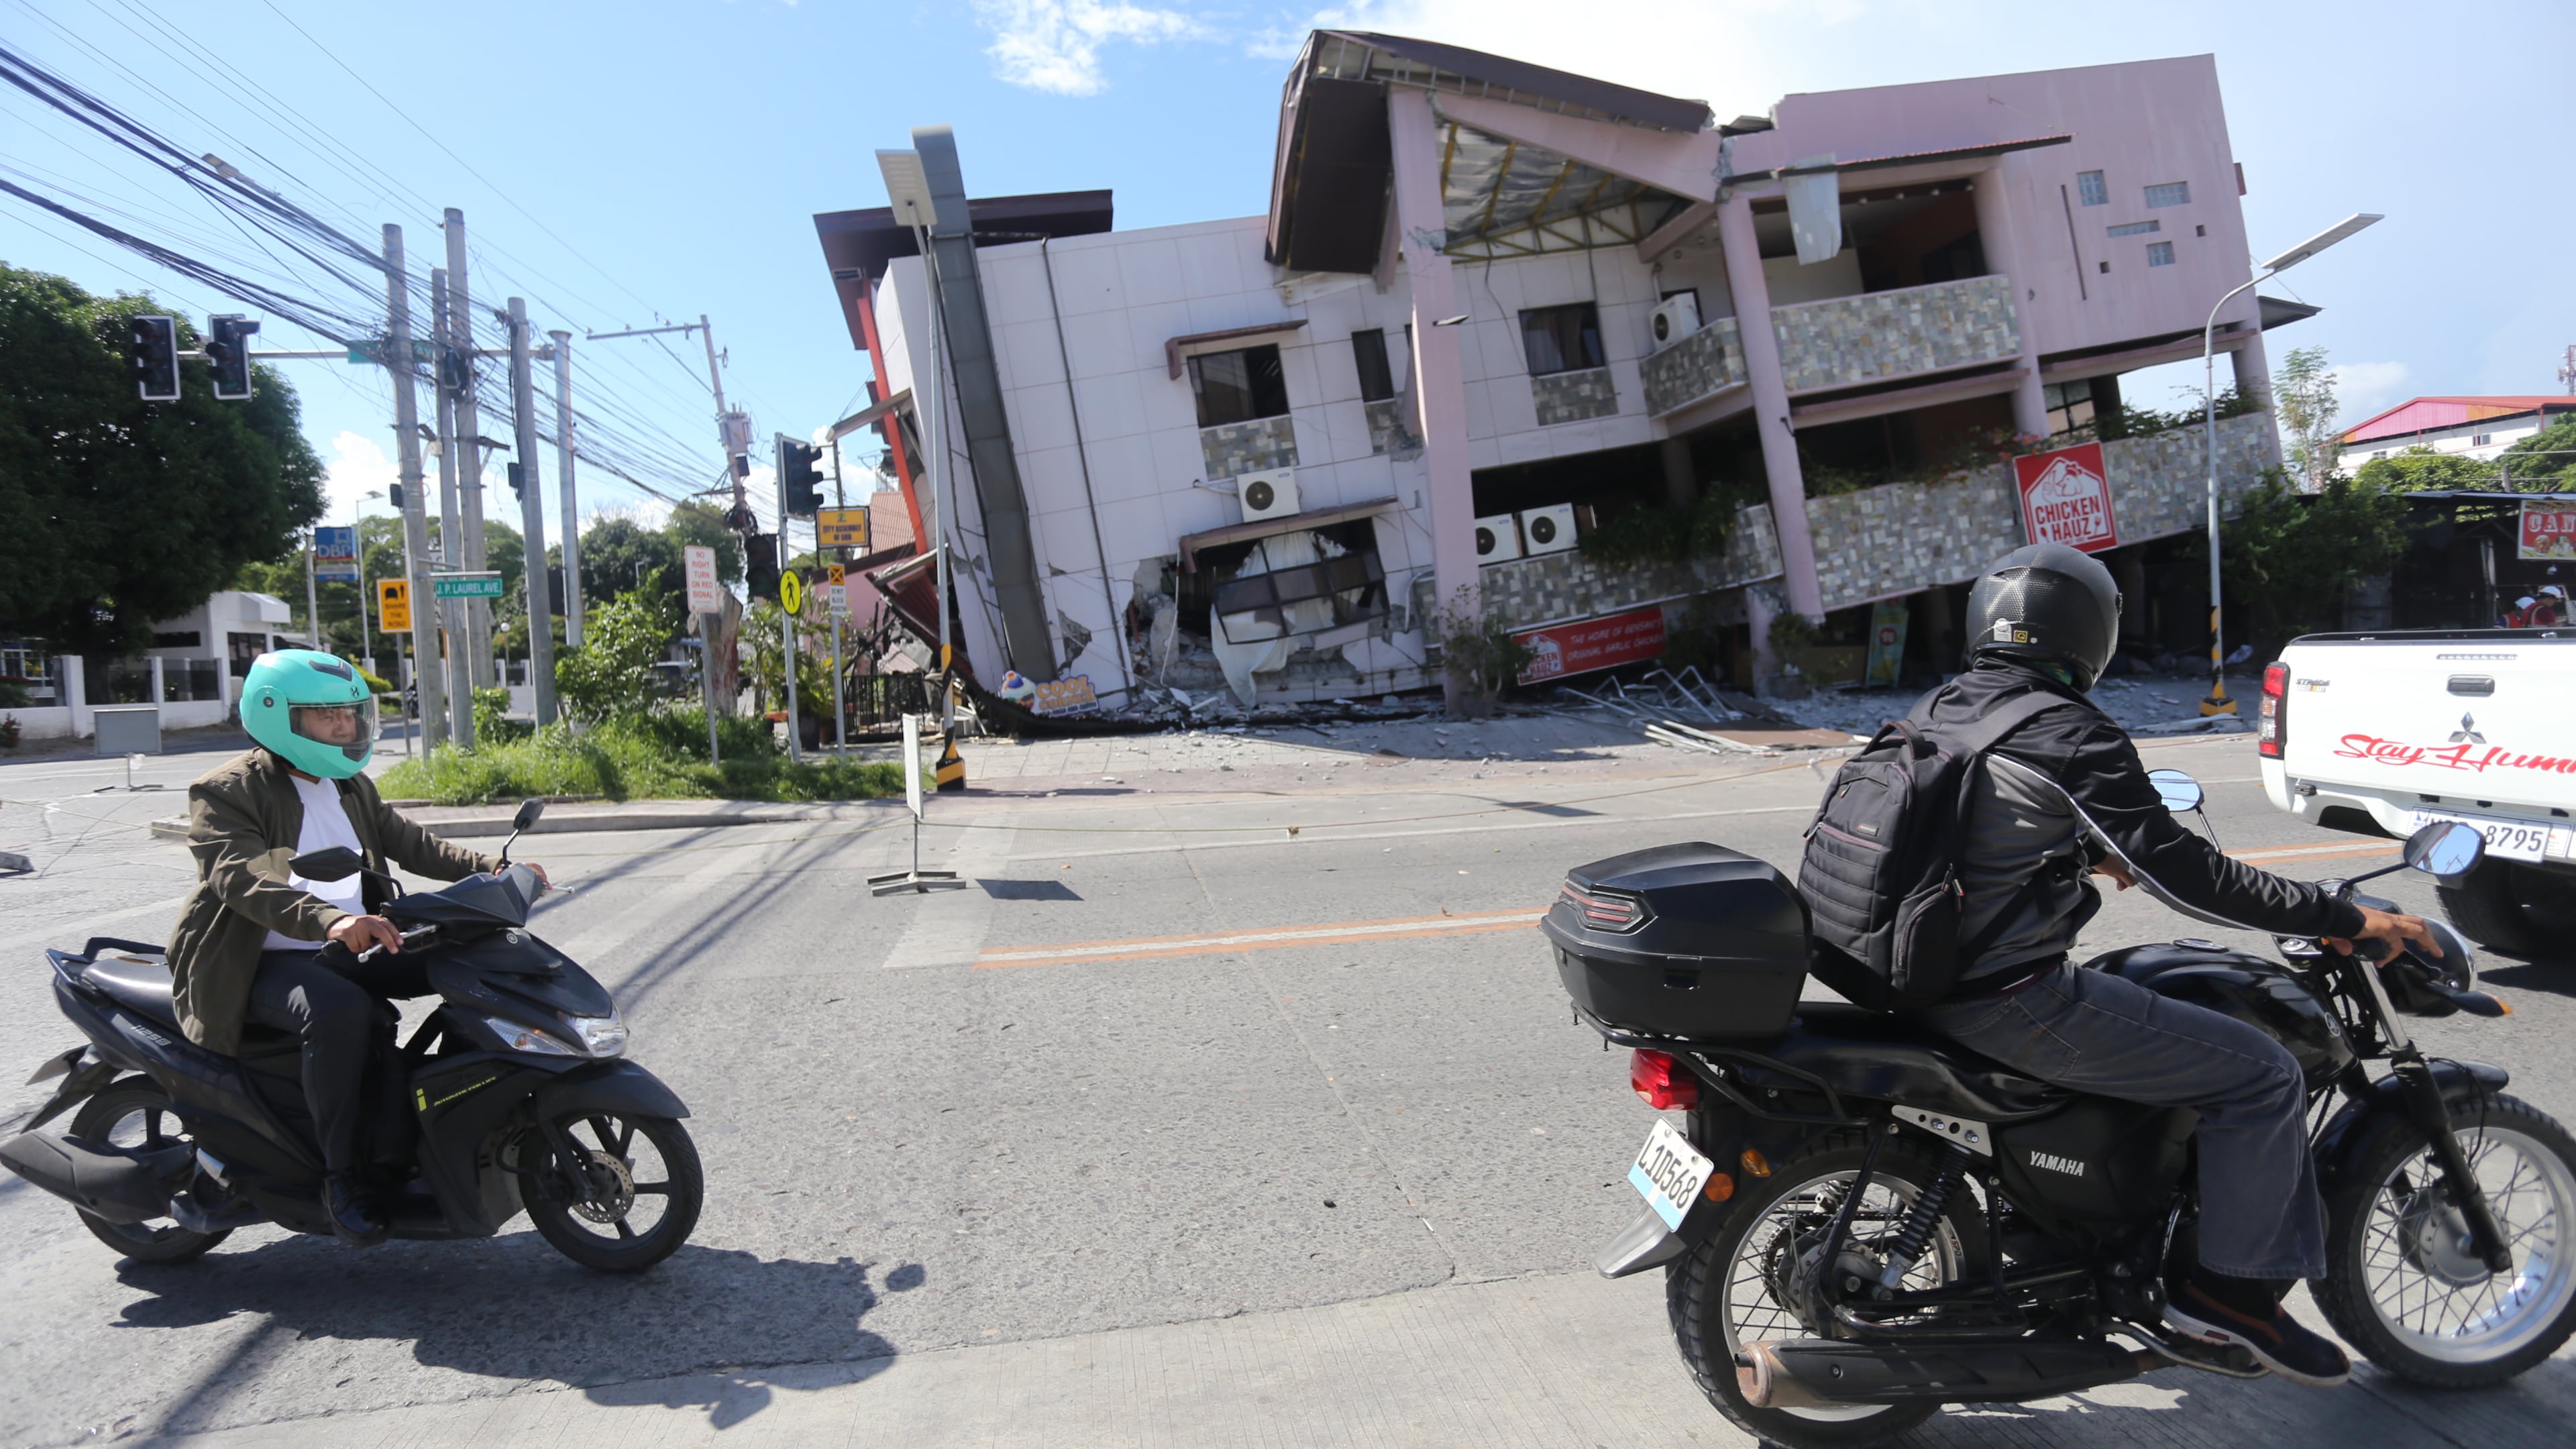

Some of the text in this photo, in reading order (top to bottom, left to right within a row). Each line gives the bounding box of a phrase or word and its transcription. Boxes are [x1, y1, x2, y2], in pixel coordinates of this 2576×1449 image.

[2035, 495, 2100, 525] CHICKEN
[2051, 517, 2092, 541] HAUZ
[317, 544, 352, 558] DBP
[692, 560, 709, 568] RIGHT
[445, 584, 451, 594] P.
[453, 583, 483, 594] LAUREL
[692, 591, 712, 599] SIGNAL
[1036, 676, 1093, 698] COOL
[2333, 733, 2426, 766] Stay
[2485, 825, 2543, 853] 8795
[1638, 1134, 1698, 1210] L1D568
[2029, 1150, 2084, 1177] YAMAHA
